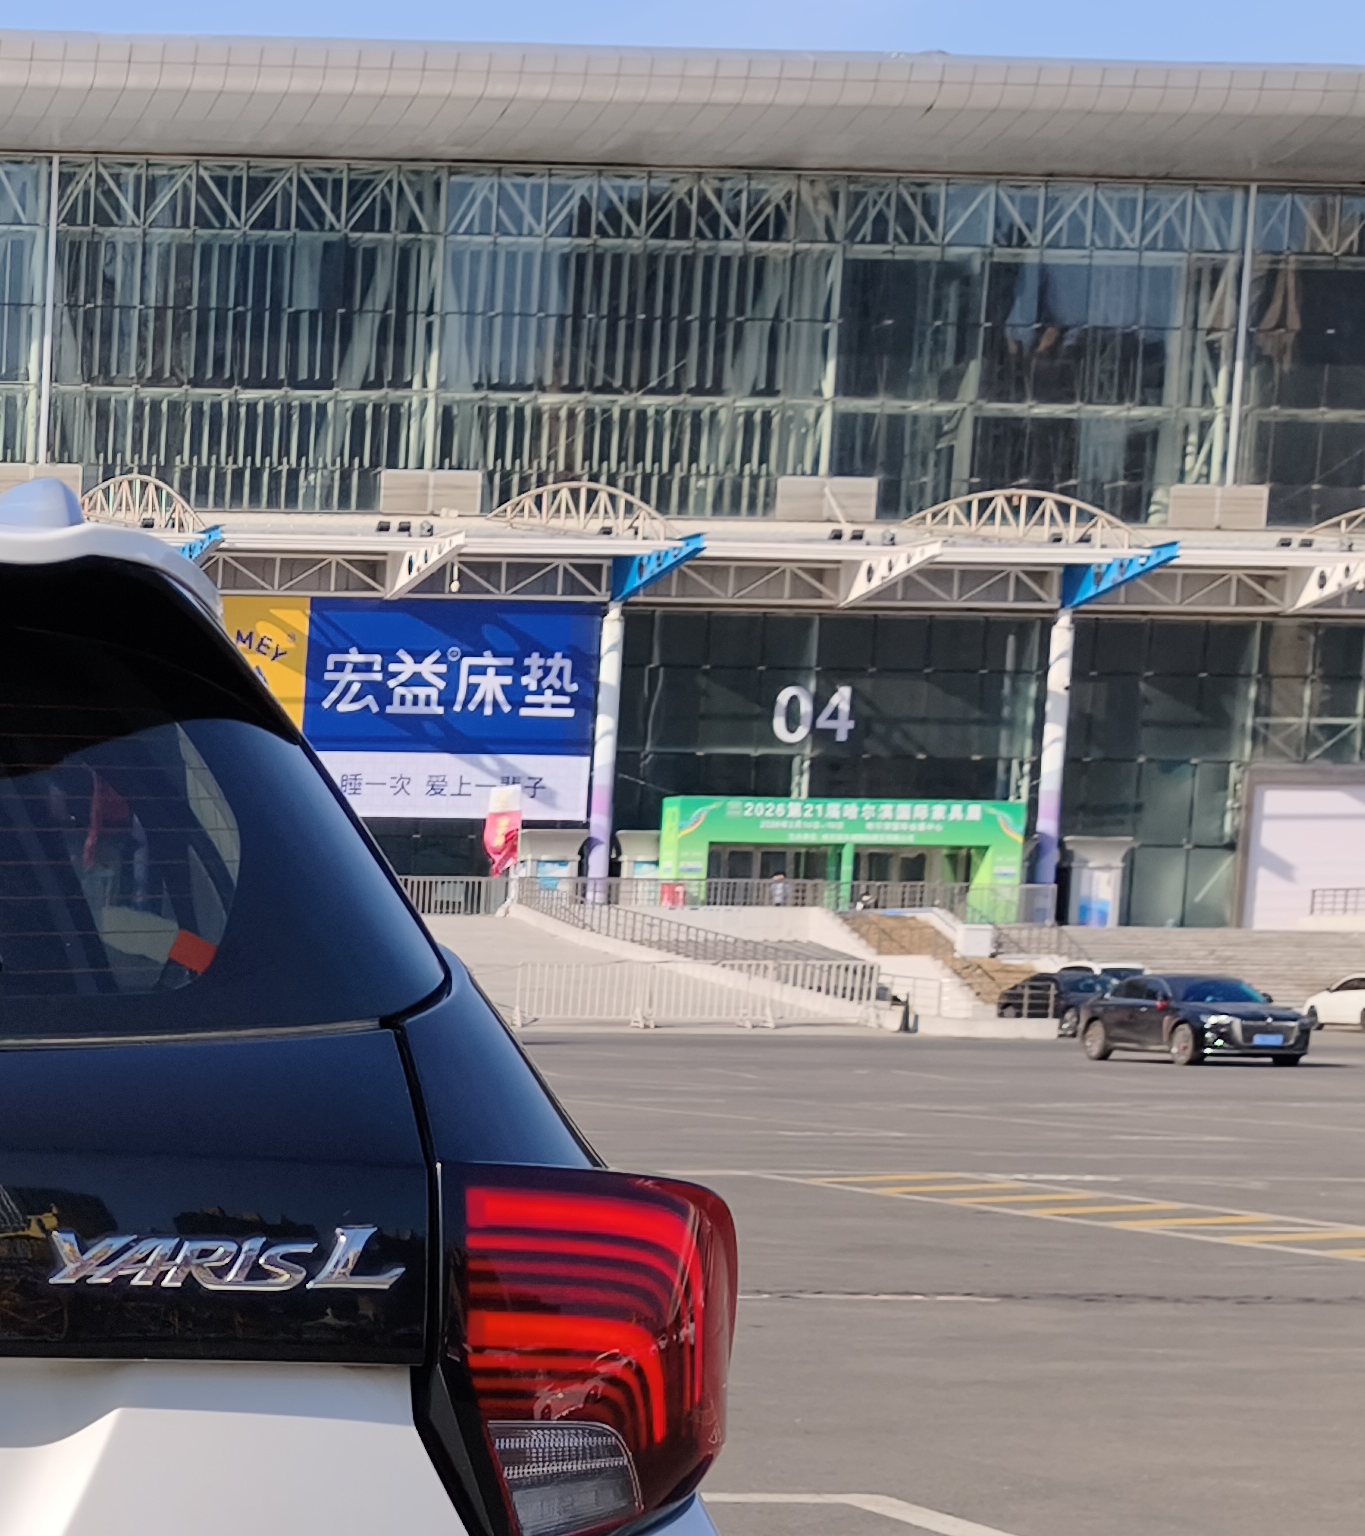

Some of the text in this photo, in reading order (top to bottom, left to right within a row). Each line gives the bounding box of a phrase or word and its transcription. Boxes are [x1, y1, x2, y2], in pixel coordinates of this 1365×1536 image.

[772, 685, 856, 744] 04
[48, 1224, 407, 1292] YARIS L
